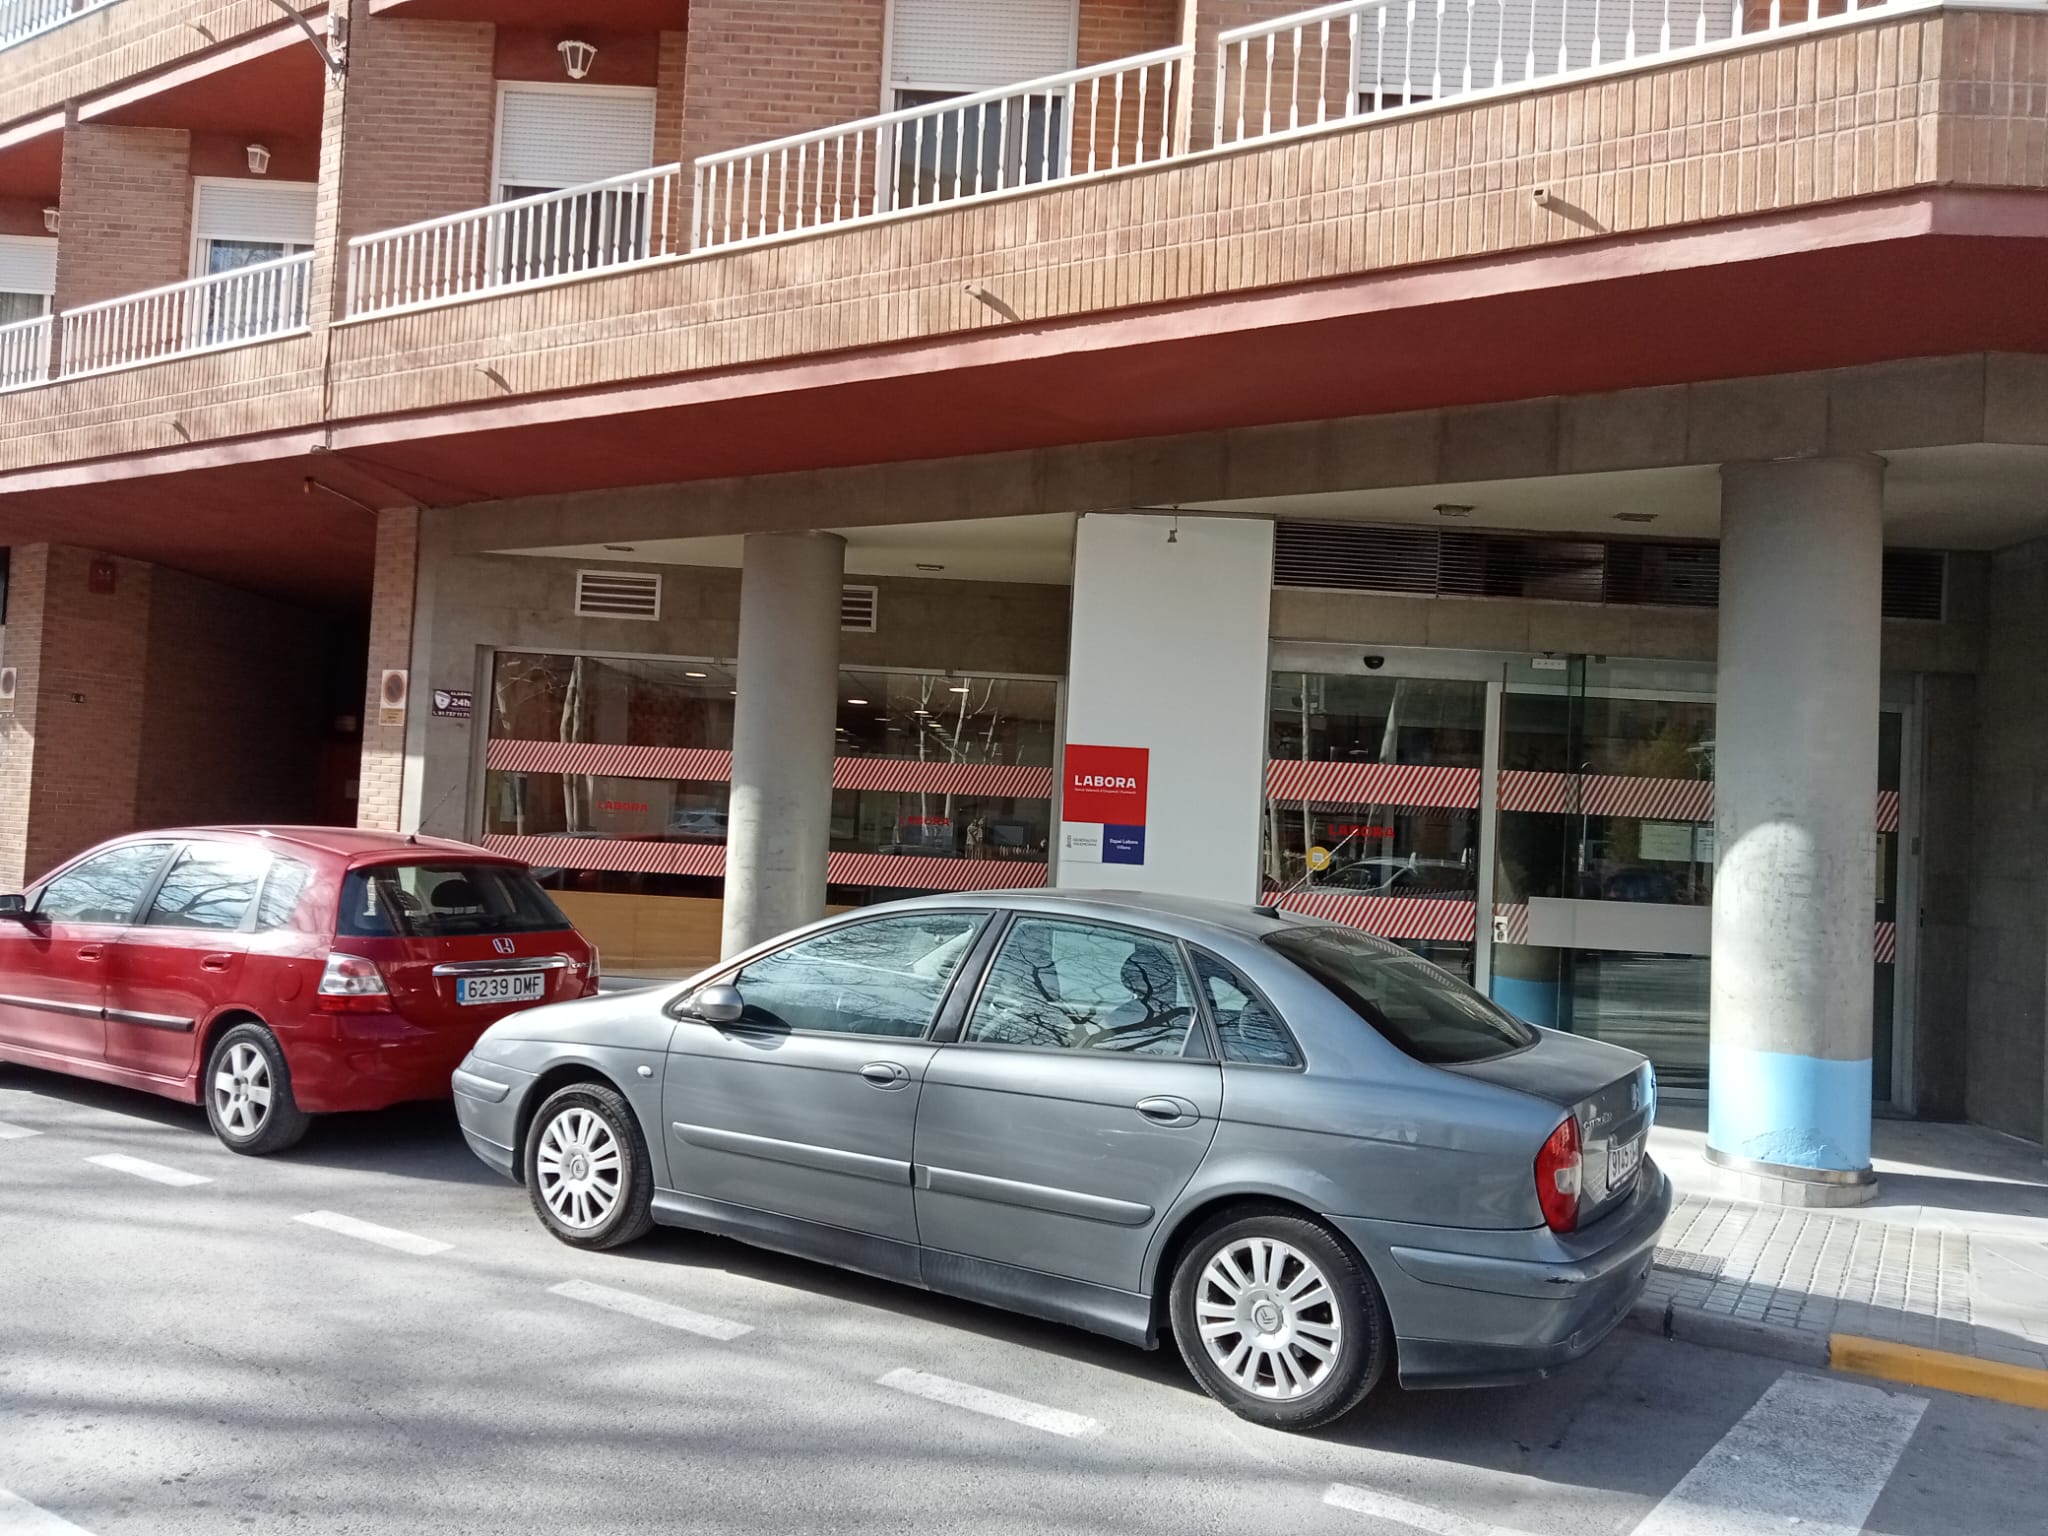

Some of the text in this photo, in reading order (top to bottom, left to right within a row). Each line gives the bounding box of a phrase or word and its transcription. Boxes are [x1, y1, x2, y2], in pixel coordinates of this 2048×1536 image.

[451, 698, 471, 707] 24h
[1074, 774, 1137, 789] LABORA
[1327, 823, 1396, 839] LABORA
[468, 975, 541, 998] 6239 DMF
